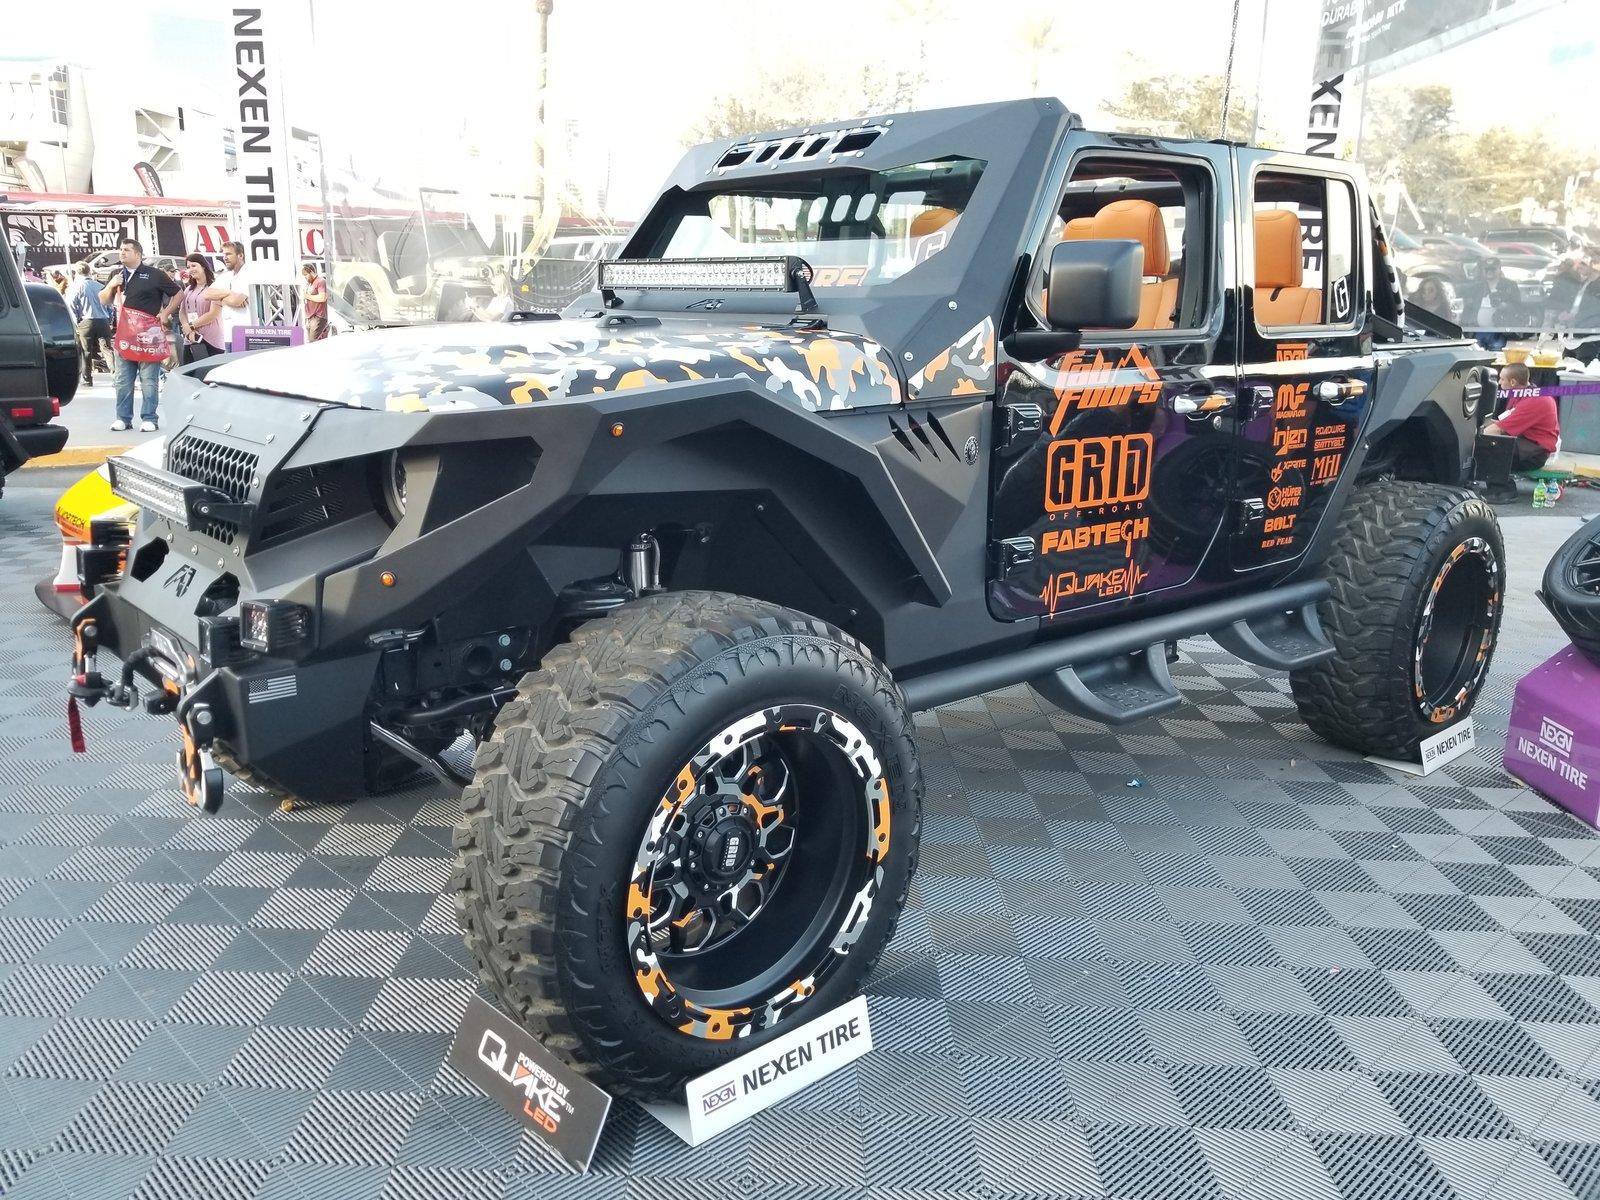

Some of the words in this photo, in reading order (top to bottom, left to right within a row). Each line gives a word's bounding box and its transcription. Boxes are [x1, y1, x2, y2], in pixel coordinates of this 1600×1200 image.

[233, 9, 271, 153] NEXEN
[41, 215, 120, 232] FRGED
[245, 167, 279, 262] TIRE
[91, 233, 120, 247] DAY
[1513, 387, 1541, 398] TIRE
[1044, 433, 1153, 512] GRID
[1049, 502, 1143, 521] OFF-ROAD
[1264, 514, 1297, 533] BOLT
[1041, 517, 1150, 558] FABTECH
[1098, 585, 1124, 598] LED
[1436, 735, 1457, 757] NEXEN
[1457, 727, 1472, 744] TIRE
[1518, 736, 1557, 773] NEXEN
[1559, 760, 1588, 790] TIRE
[742, 1041, 813, 1095] NEXEN
[816, 1016, 861, 1054] TIRE
[478, 1029, 561, 1123] QUAKE
[517, 1051, 557, 1089] POWERED
[555, 1081, 571, 1099] BY
[523, 1098, 557, 1133] LED
